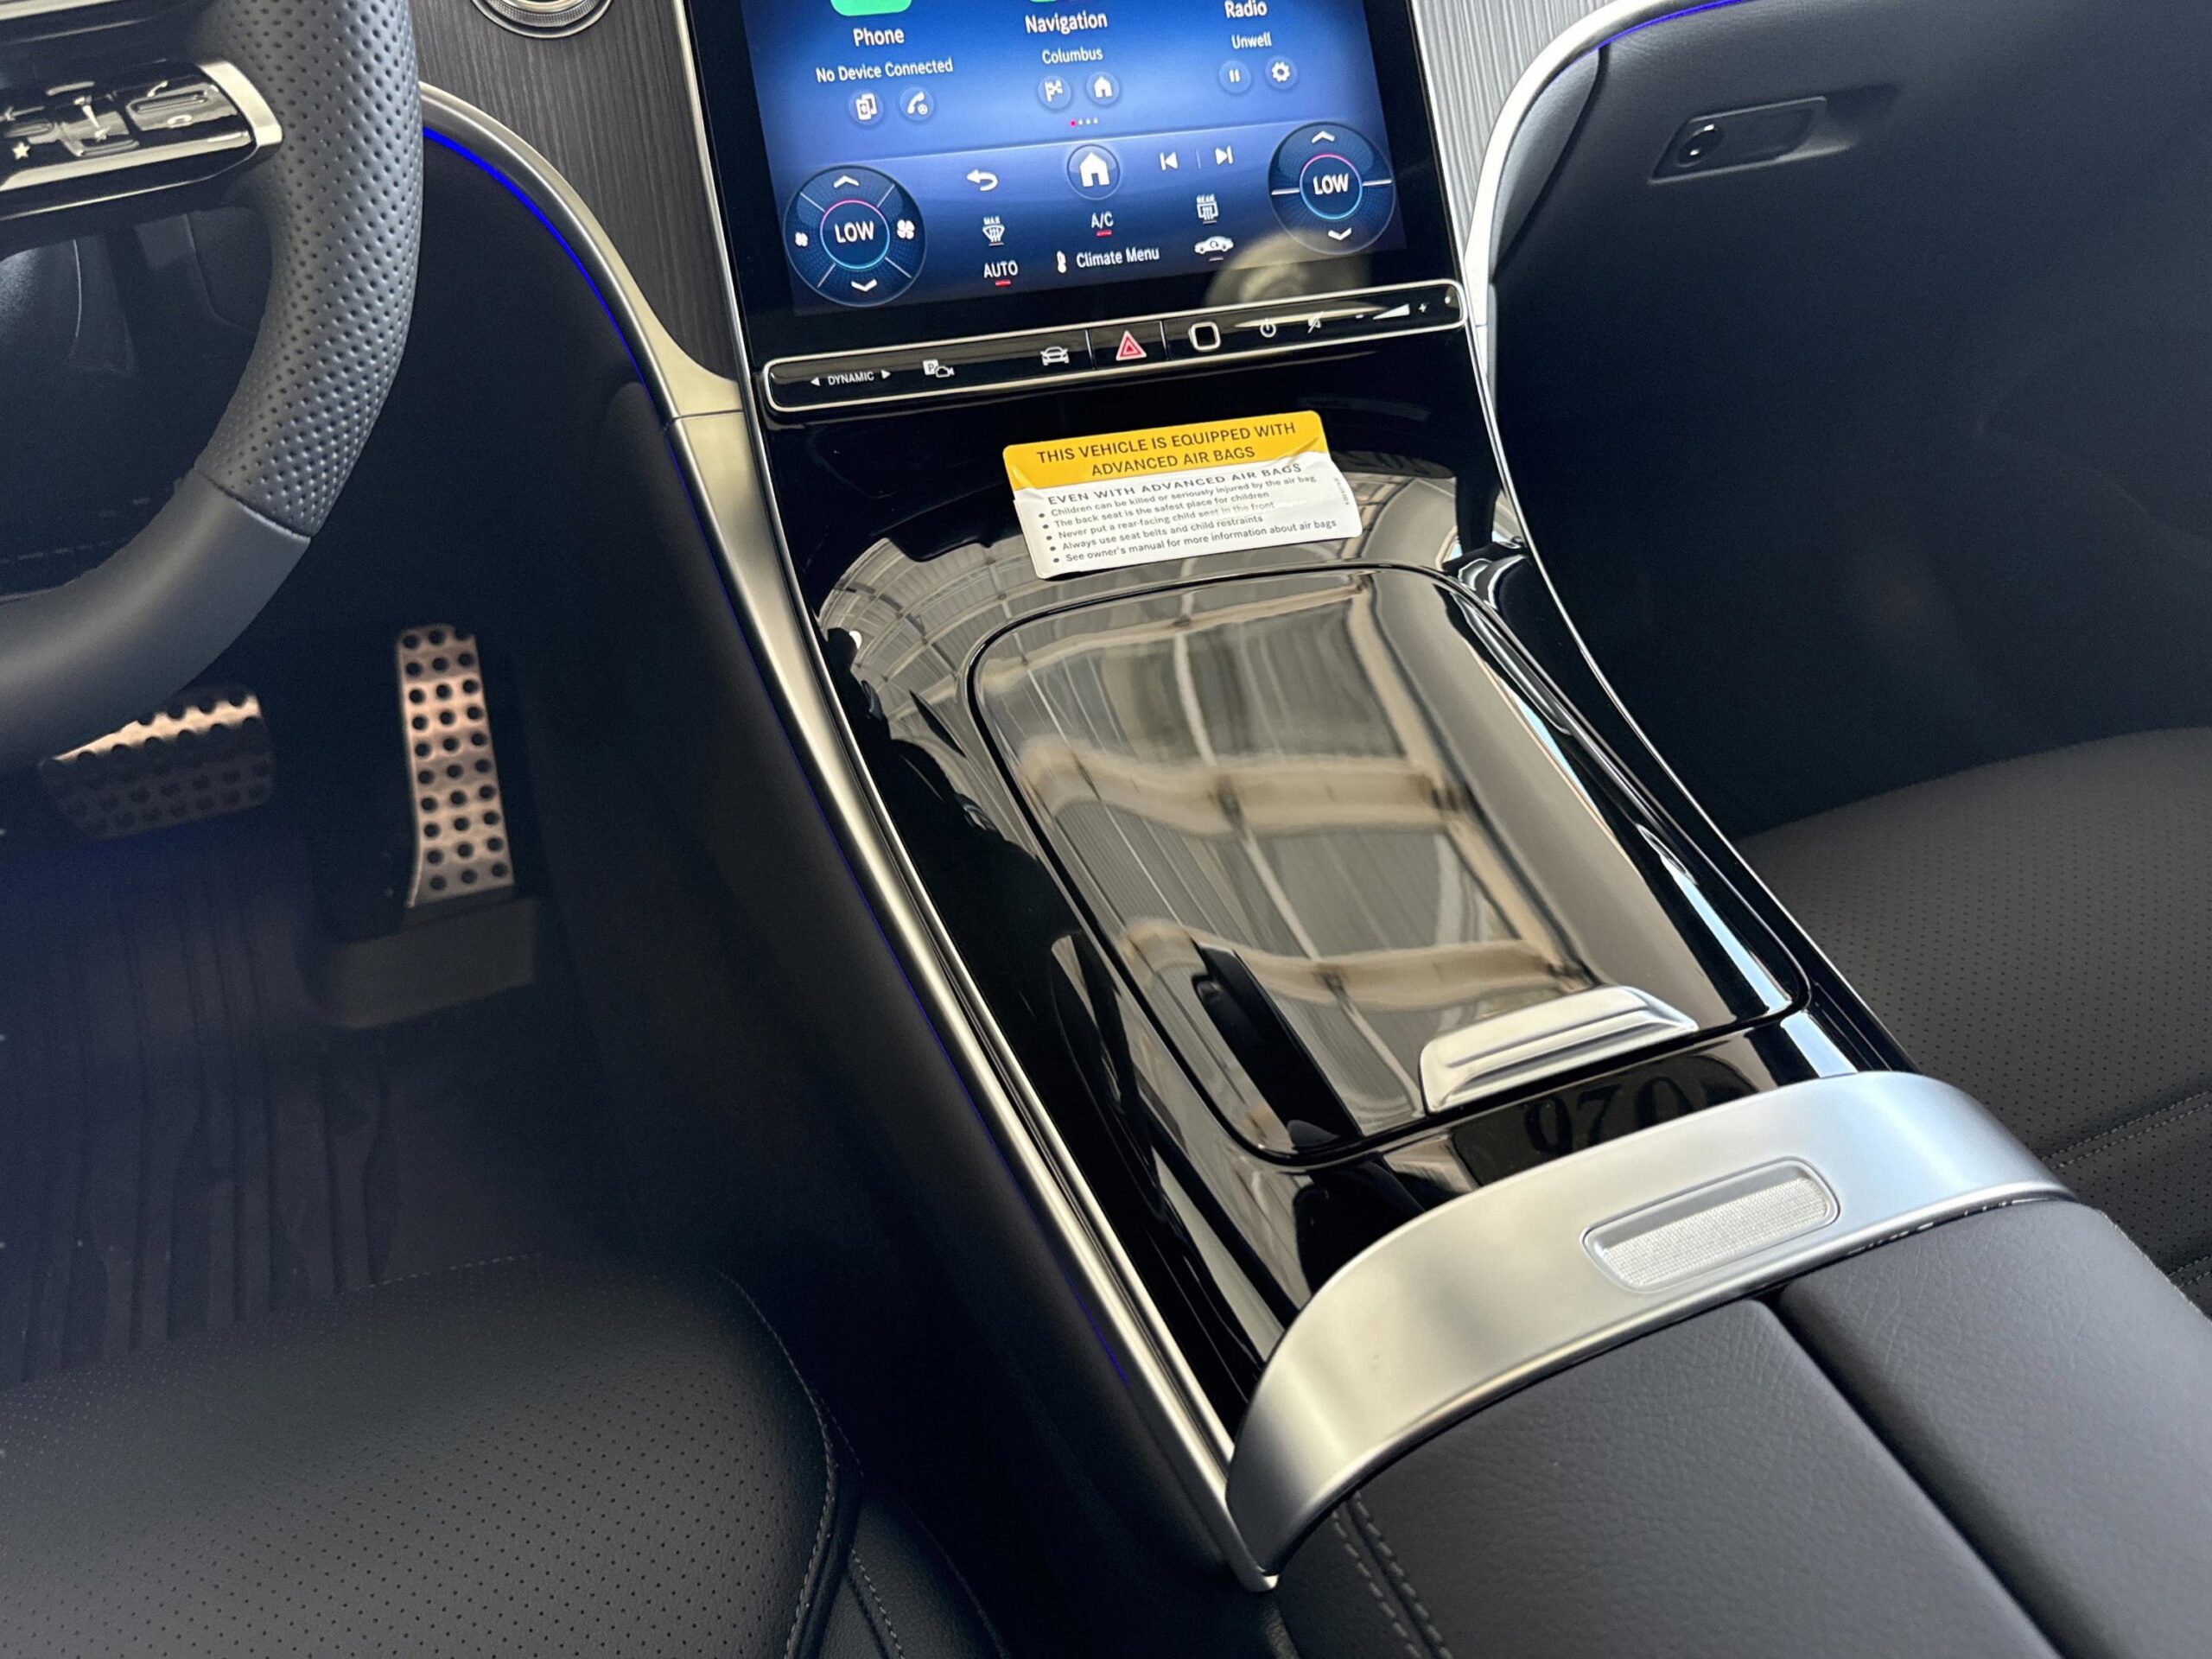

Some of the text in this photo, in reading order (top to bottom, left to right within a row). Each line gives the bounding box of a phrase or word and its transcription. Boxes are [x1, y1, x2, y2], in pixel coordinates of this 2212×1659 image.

[1224, 0, 1268, 18] Radio
[1025, 11, 1108, 34] Navigation
[854, 28, 905, 47] Phone
[1231, 32, 1272, 49] Unwell
[1042, 48, 1103, 64] Columbus
[816, 57, 953, 83] No Device Connected
[1313, 174, 1349, 195] LOW
[1091, 212, 1114, 229] A/C
[835, 221, 874, 243] LOW
[1077, 247, 1160, 269] Climate Menu
[983, 261, 1019, 278] AUTO
[828, 372, 874, 386] DYNAMIC
[1037, 423, 1295, 463] THIS VEHICLE IS EQUIPPED WITH
[1092, 447, 1255, 476] ADVANCED AIR BAGS
[1048, 464, 1301, 505] EVEN WITH ADVANCED AIR BAGS
[1052, 505, 1093, 517] Children
[1095, 502, 1113, 511] can
[1116, 499, 1127, 507] be
[1129, 495, 1155, 505] killed
[1171, 486, 1214, 499] seriously
[1216, 484, 1249, 495] injured
[1299, 474, 1316, 483] bag
[1076, 516, 1099, 525] back
[1101, 511, 1122, 520] seat
[1136, 505, 1152, 514] the
[1154, 501, 1184, 512] safest
[1187, 499, 1212, 510] place
[1230, 491, 1269, 502] children
[1058, 530, 1087, 539] Never
[1091, 526, 1106, 536] put
[1117, 518, 1170, 530] rear-facing
[1172, 509, 1195, 520] child
[1198, 509, 1218, 518] seat
[1232, 505, 1249, 513] the
[1251, 501, 1274, 511] front
[1063, 540, 1096, 550] Always
[1099, 536, 1116, 544] use
[1120, 531, 1141, 541] seat
[1143, 528, 1167, 537] belts
[1191, 522, 1214, 531] child
[1217, 515, 1262, 528] restraints
[1087, 546, 1126, 559] owner's
[1128, 542, 1164, 553] manual
[1166, 537, 1180, 548] for
[1184, 536, 1209, 545] more
[1211, 525, 1267, 541] information
[1270, 523, 1297, 534] about
[1300, 521, 1311, 531] air
[1313, 520, 1336, 530] bags
